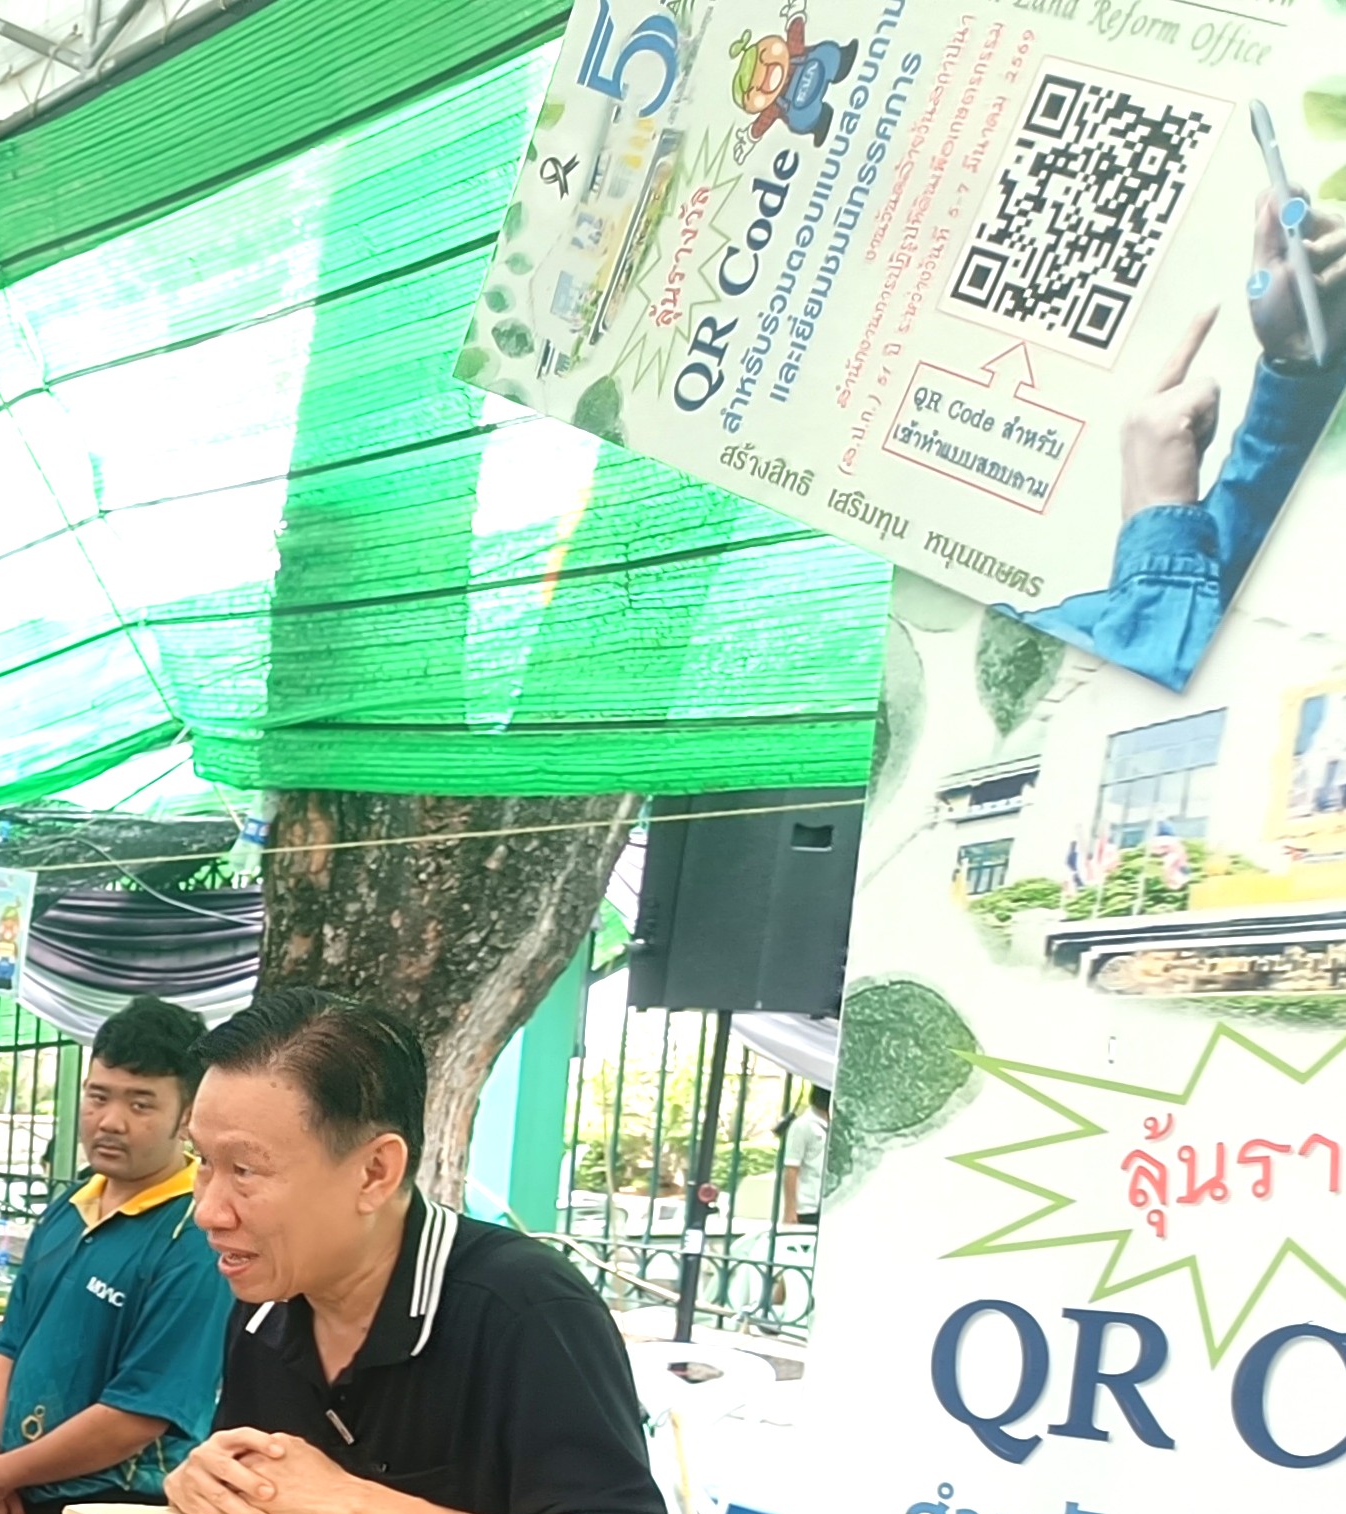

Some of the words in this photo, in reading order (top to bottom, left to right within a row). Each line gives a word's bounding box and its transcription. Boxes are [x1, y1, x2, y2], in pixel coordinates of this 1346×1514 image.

[1006, 28, 1038, 83] 2569
[1087, 2, 1182, 43] Reform
[1190, 21, 1273, 67] Office
[648, 187, 711, 328] ลุ้นรางวัล
[672, 316, 738, 414] QR
[719, 148, 800, 299] Code
[771, 51, 922, 404] และเยี่ยมชมนิทรรศการ
[894, 416, 1051, 501] เข้าทำแบบสอบถาม
[912, 386, 945, 414] QR
[946, 397, 995, 434] Code
[1001, 409, 1065, 462] สำหรับ
[719, 443, 815, 498] สร้างสิทธิ
[827, 489, 910, 541] เสริมทุน
[923, 531, 1044, 599] หนุนเกษตร
[1120, 1113, 1340, 1239] ลุ้นรา
[930, 1298, 1177, 1465] QR
[1231, 1320, 1346, 1469] C
